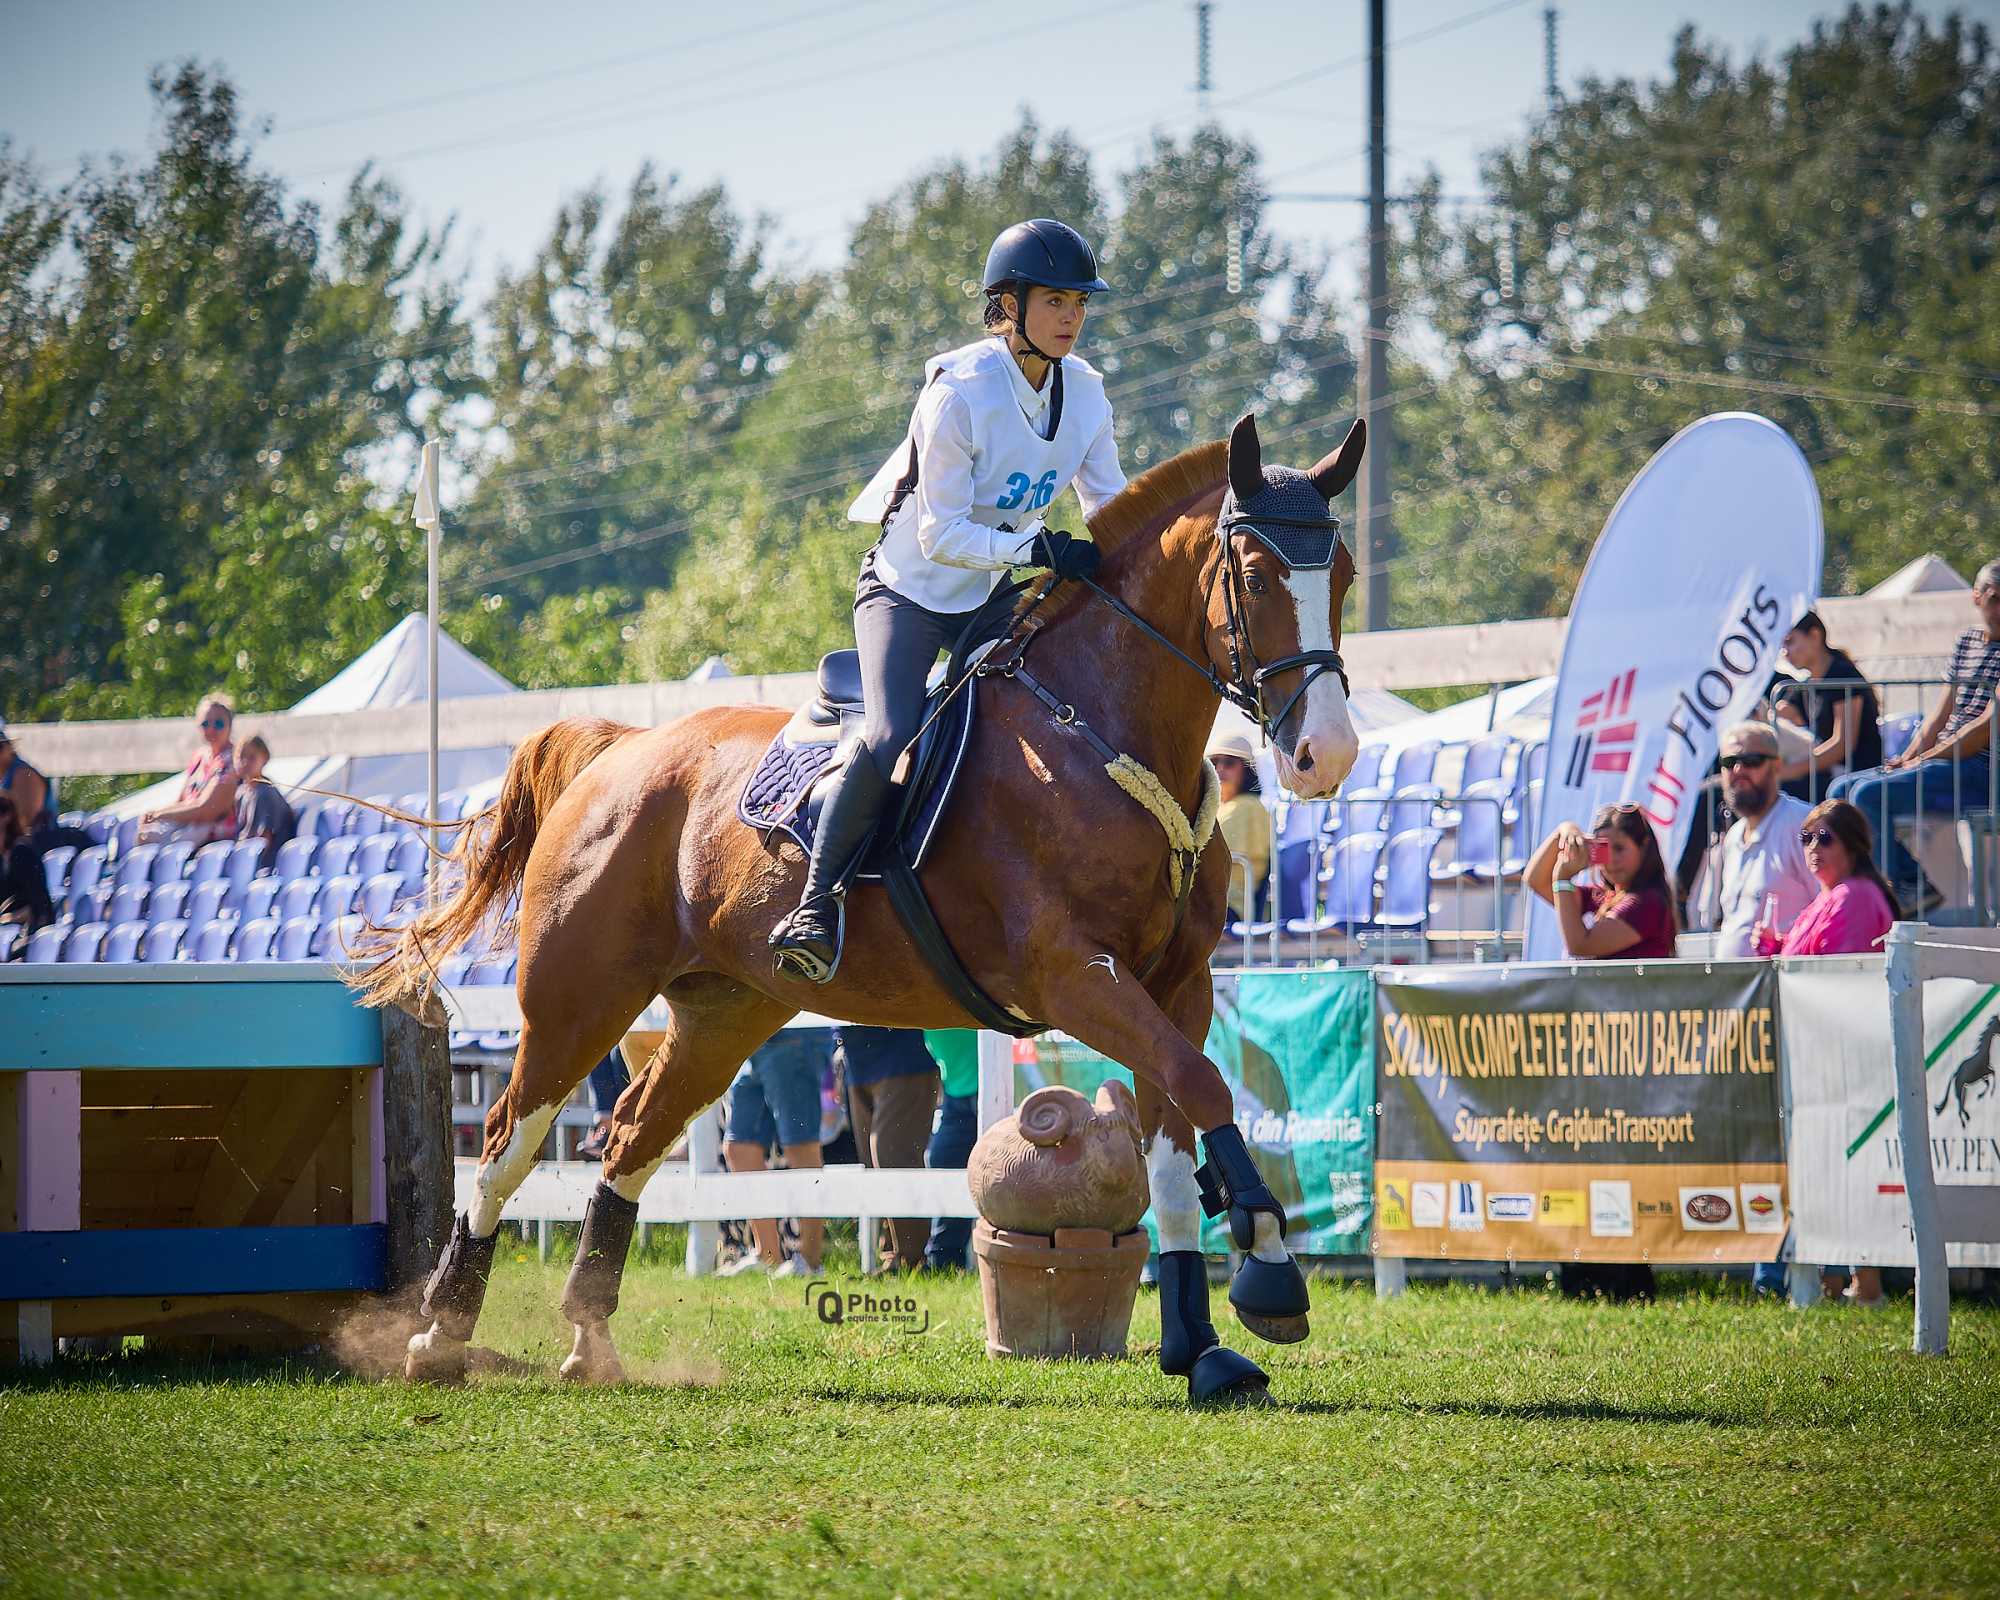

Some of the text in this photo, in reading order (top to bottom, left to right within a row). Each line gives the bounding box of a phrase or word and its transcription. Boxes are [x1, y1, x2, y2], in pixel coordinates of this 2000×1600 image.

[1667, 584, 1780, 757] Floors
[1458, 1012, 1568, 1079] COMPLETE
[1570, 1010, 1649, 1077] PENTRU
[1652, 1009, 1705, 1076] BAZE
[1705, 1007, 1776, 1074] HIPICE
[1250, 1108, 1284, 1143] din
